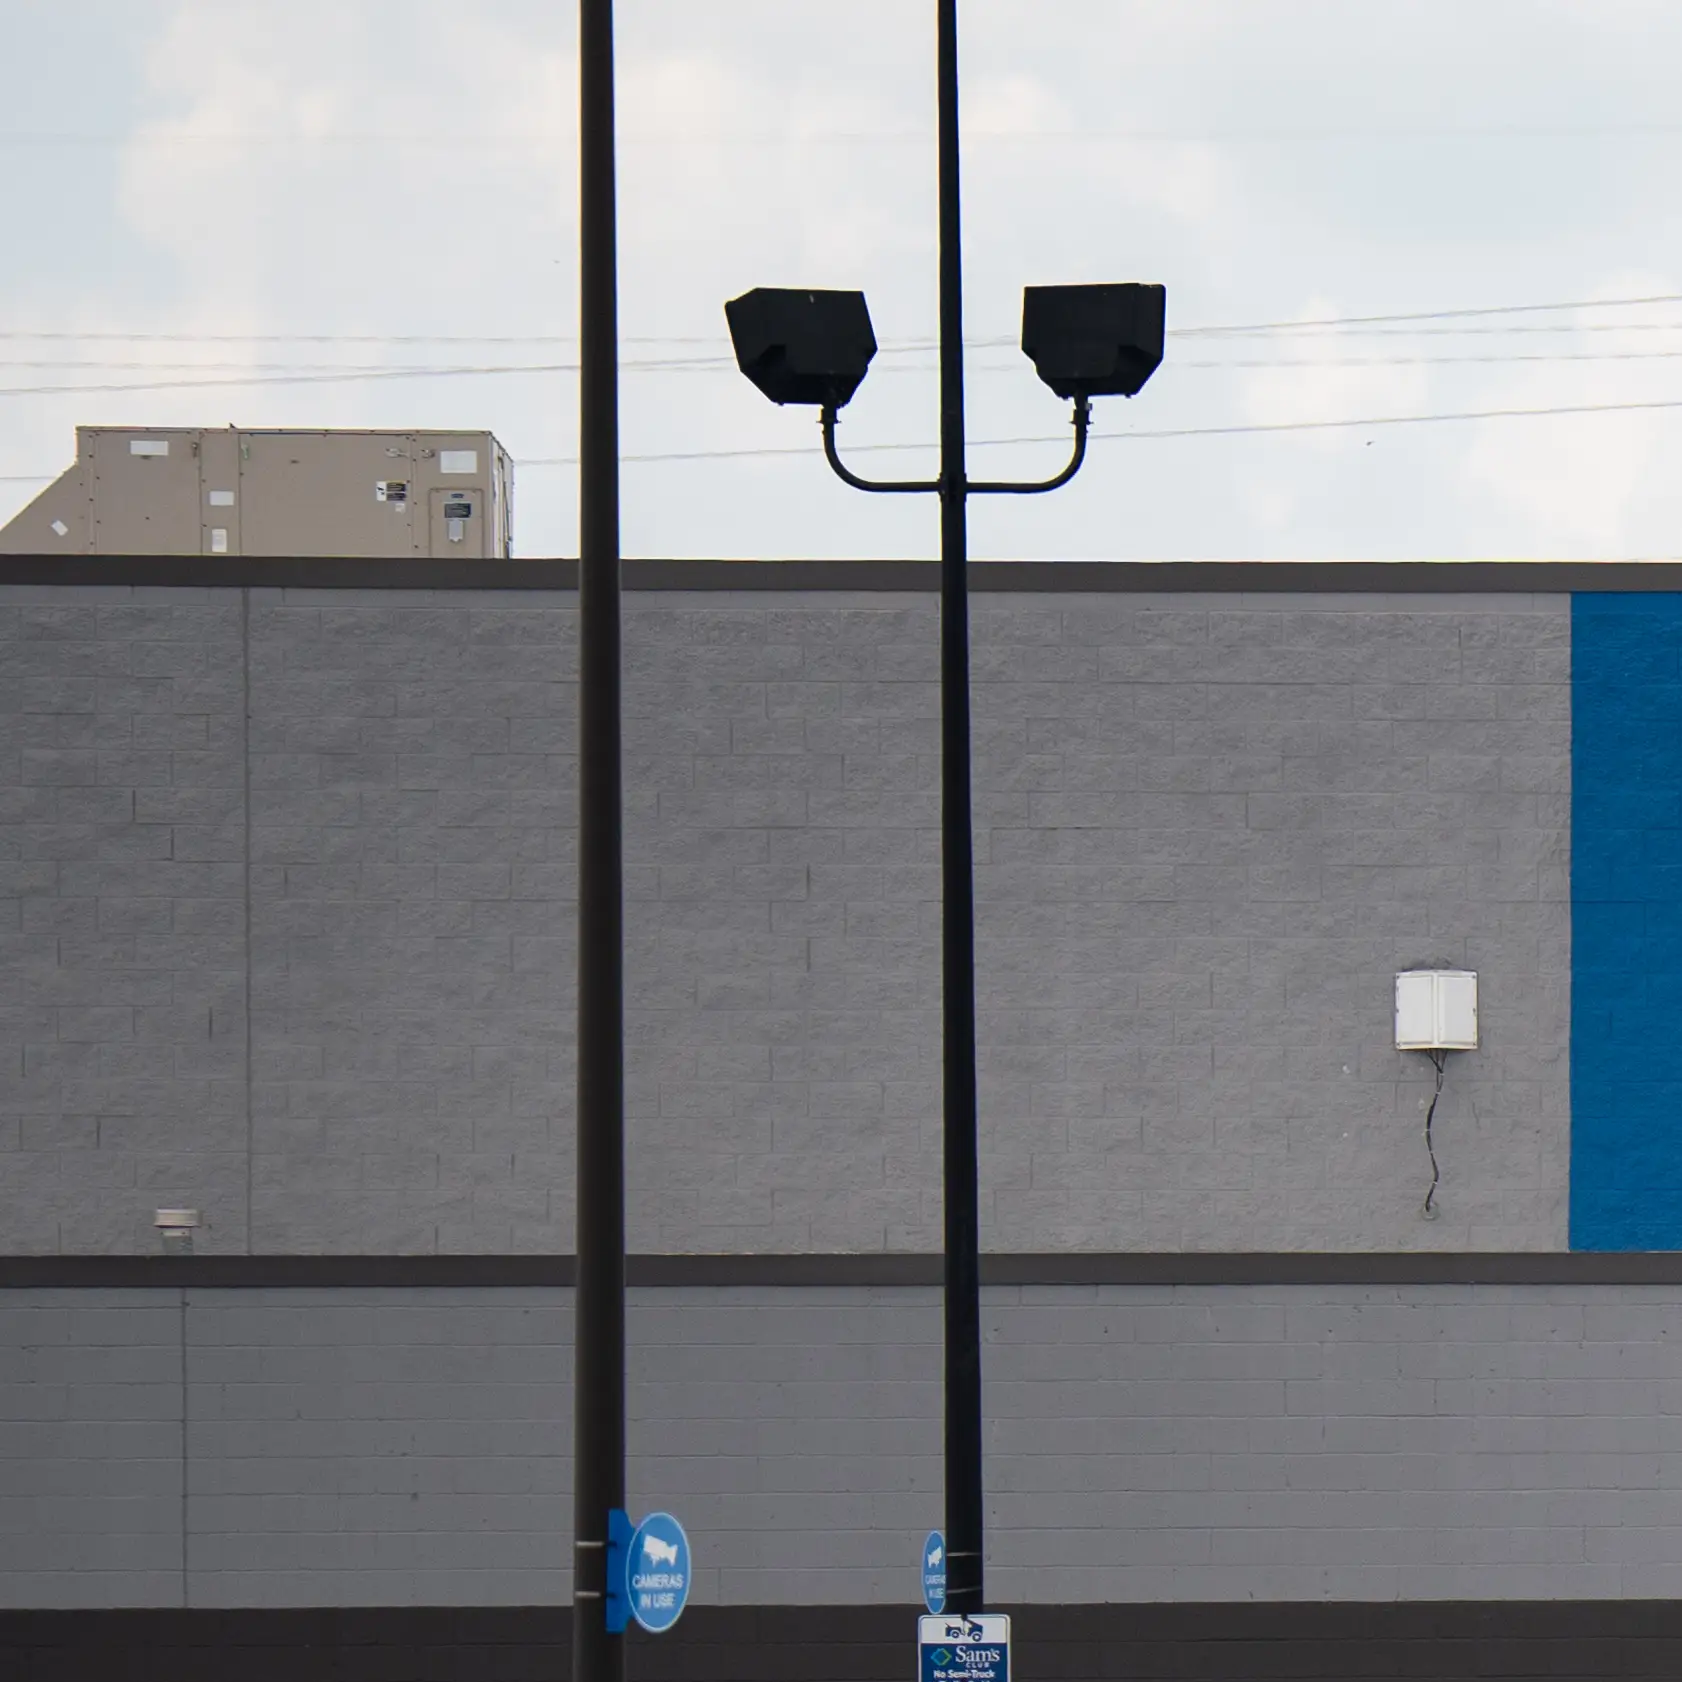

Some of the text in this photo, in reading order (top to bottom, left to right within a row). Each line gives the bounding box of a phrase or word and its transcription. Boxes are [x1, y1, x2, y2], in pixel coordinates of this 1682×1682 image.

[632, 1573, 684, 1590] CAMERAS
[641, 1592, 676, 1609] IN USE
[955, 1645, 1000, 1663] Sam's
[933, 1669, 995, 1679] No Semi-Truck
